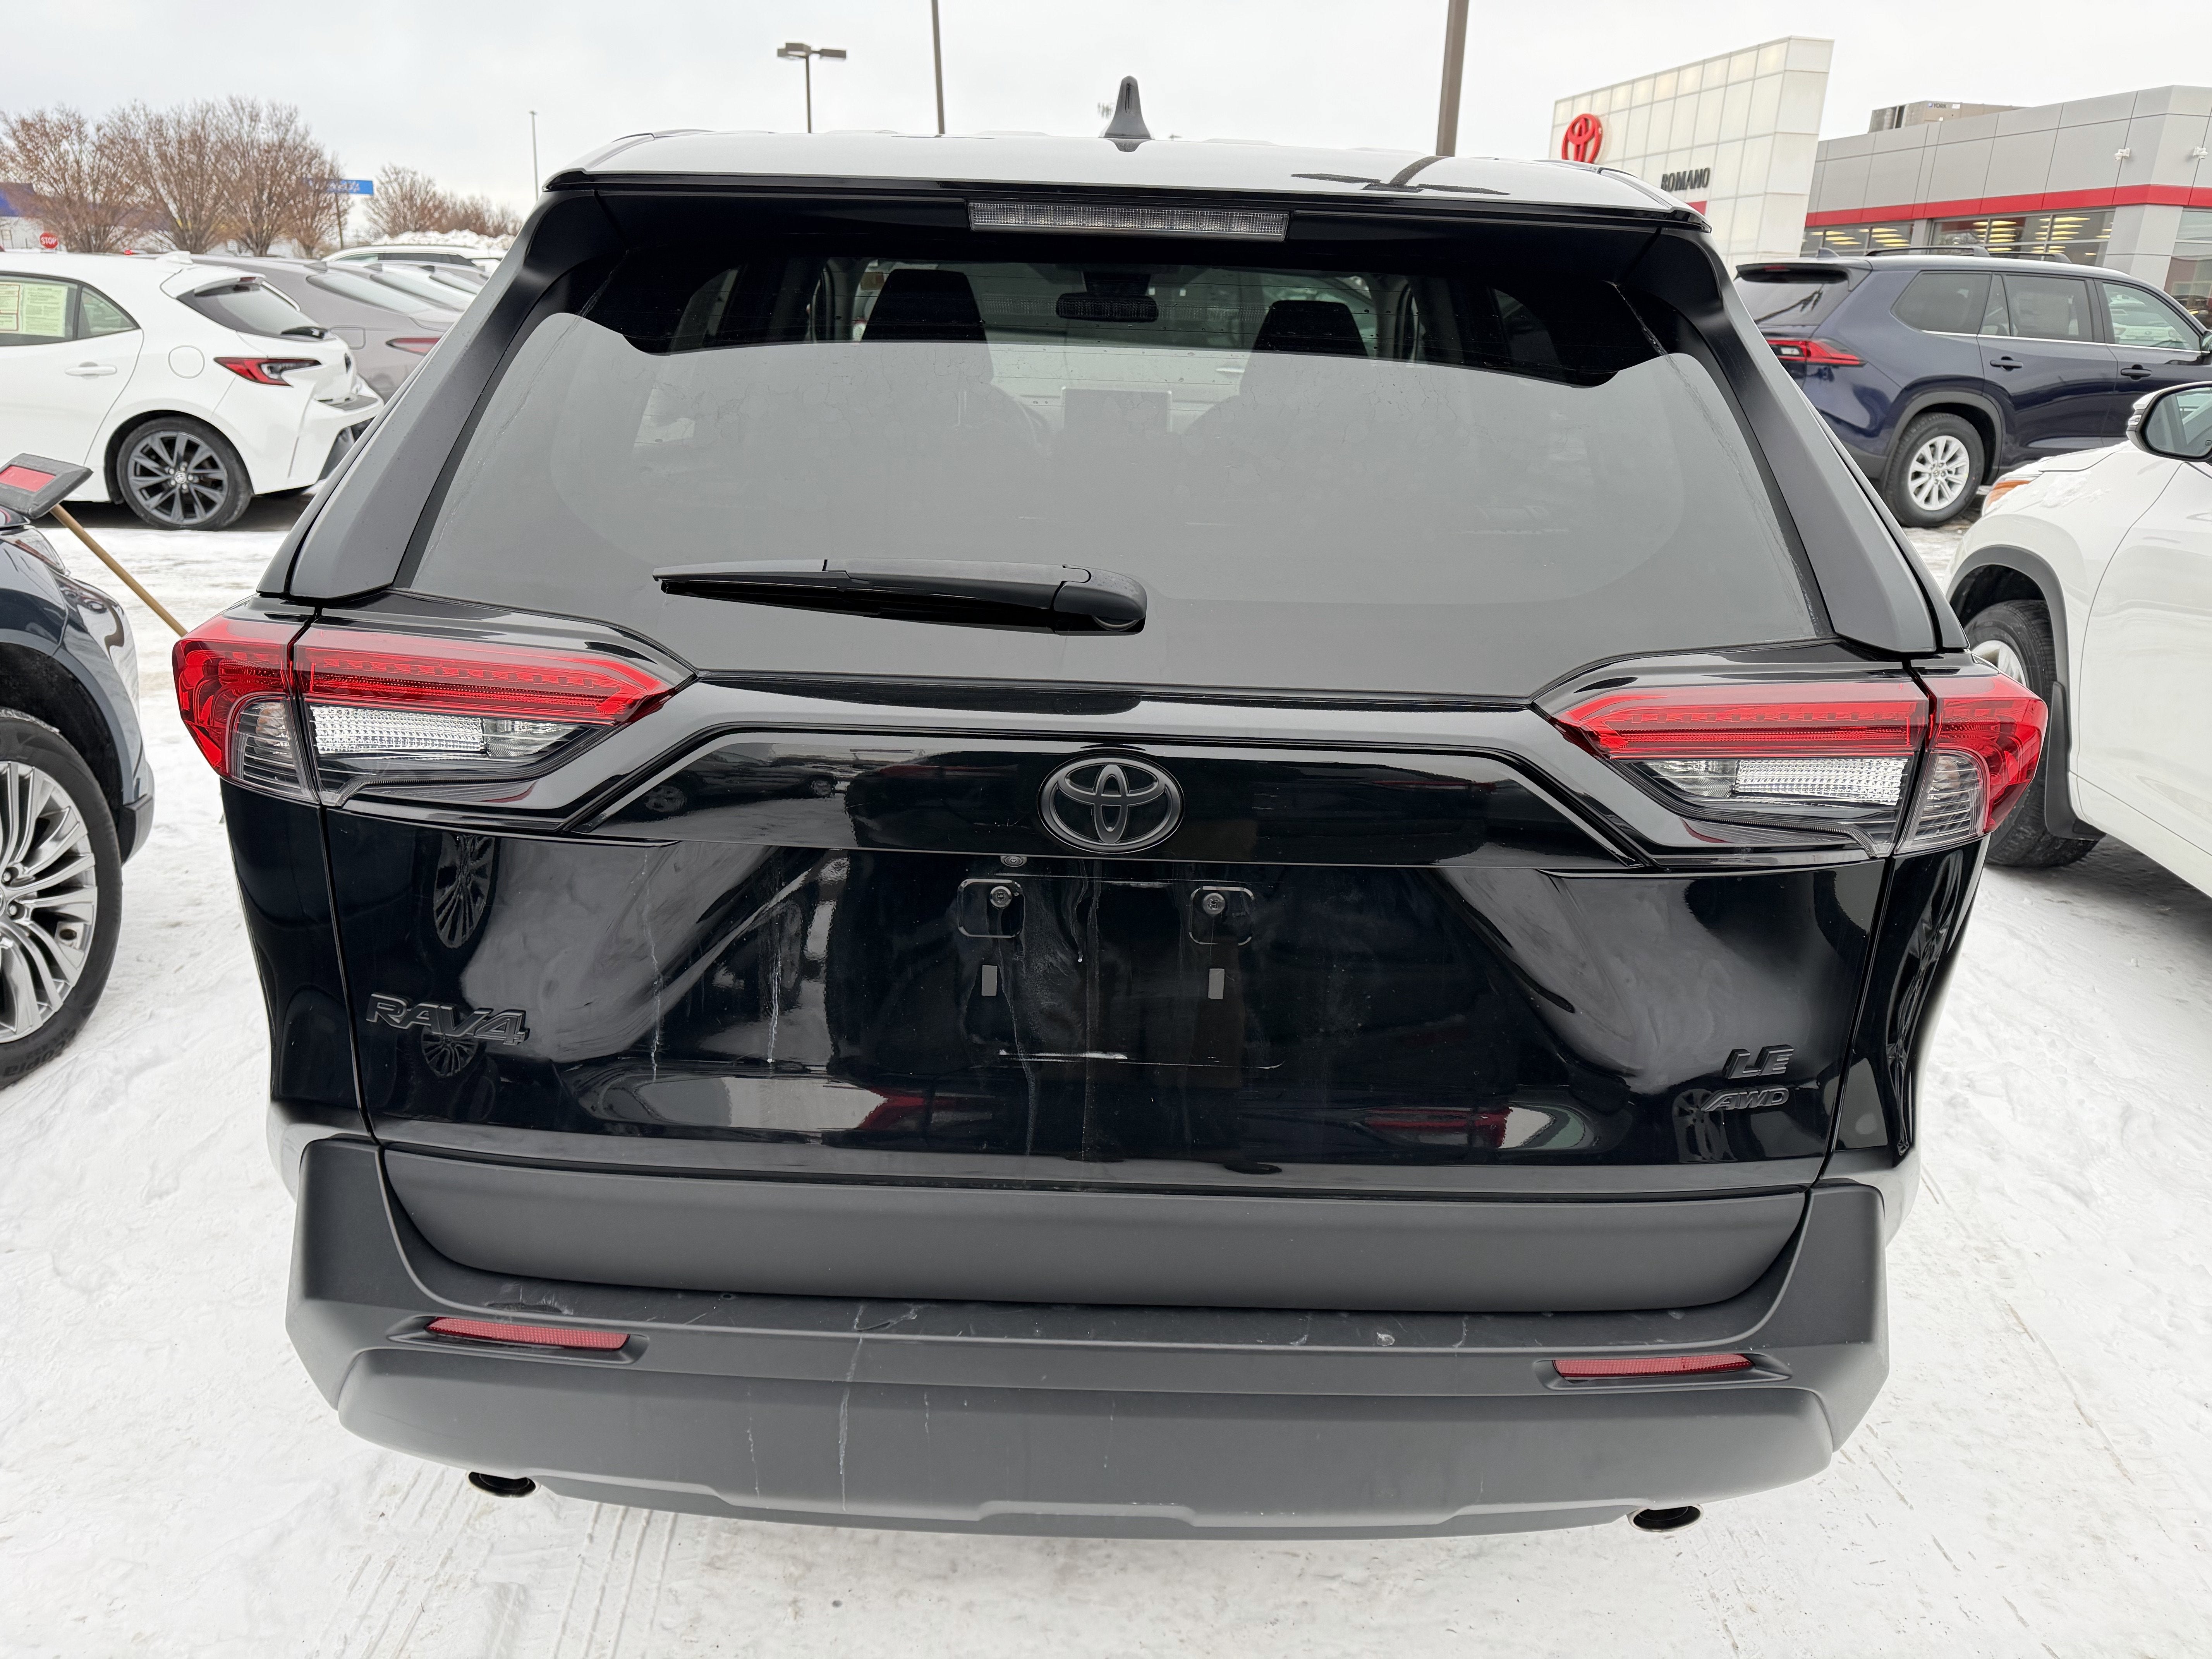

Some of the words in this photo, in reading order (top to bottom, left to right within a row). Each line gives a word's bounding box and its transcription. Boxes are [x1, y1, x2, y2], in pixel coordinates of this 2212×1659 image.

[1661, 167, 1710, 192] ROMANO
[41, 236, 57, 245] STOP
[366, 993, 530, 1045] RAV4
[1723, 1044, 1794, 1079] LE
[1700, 1085, 1789, 1112] AWD
